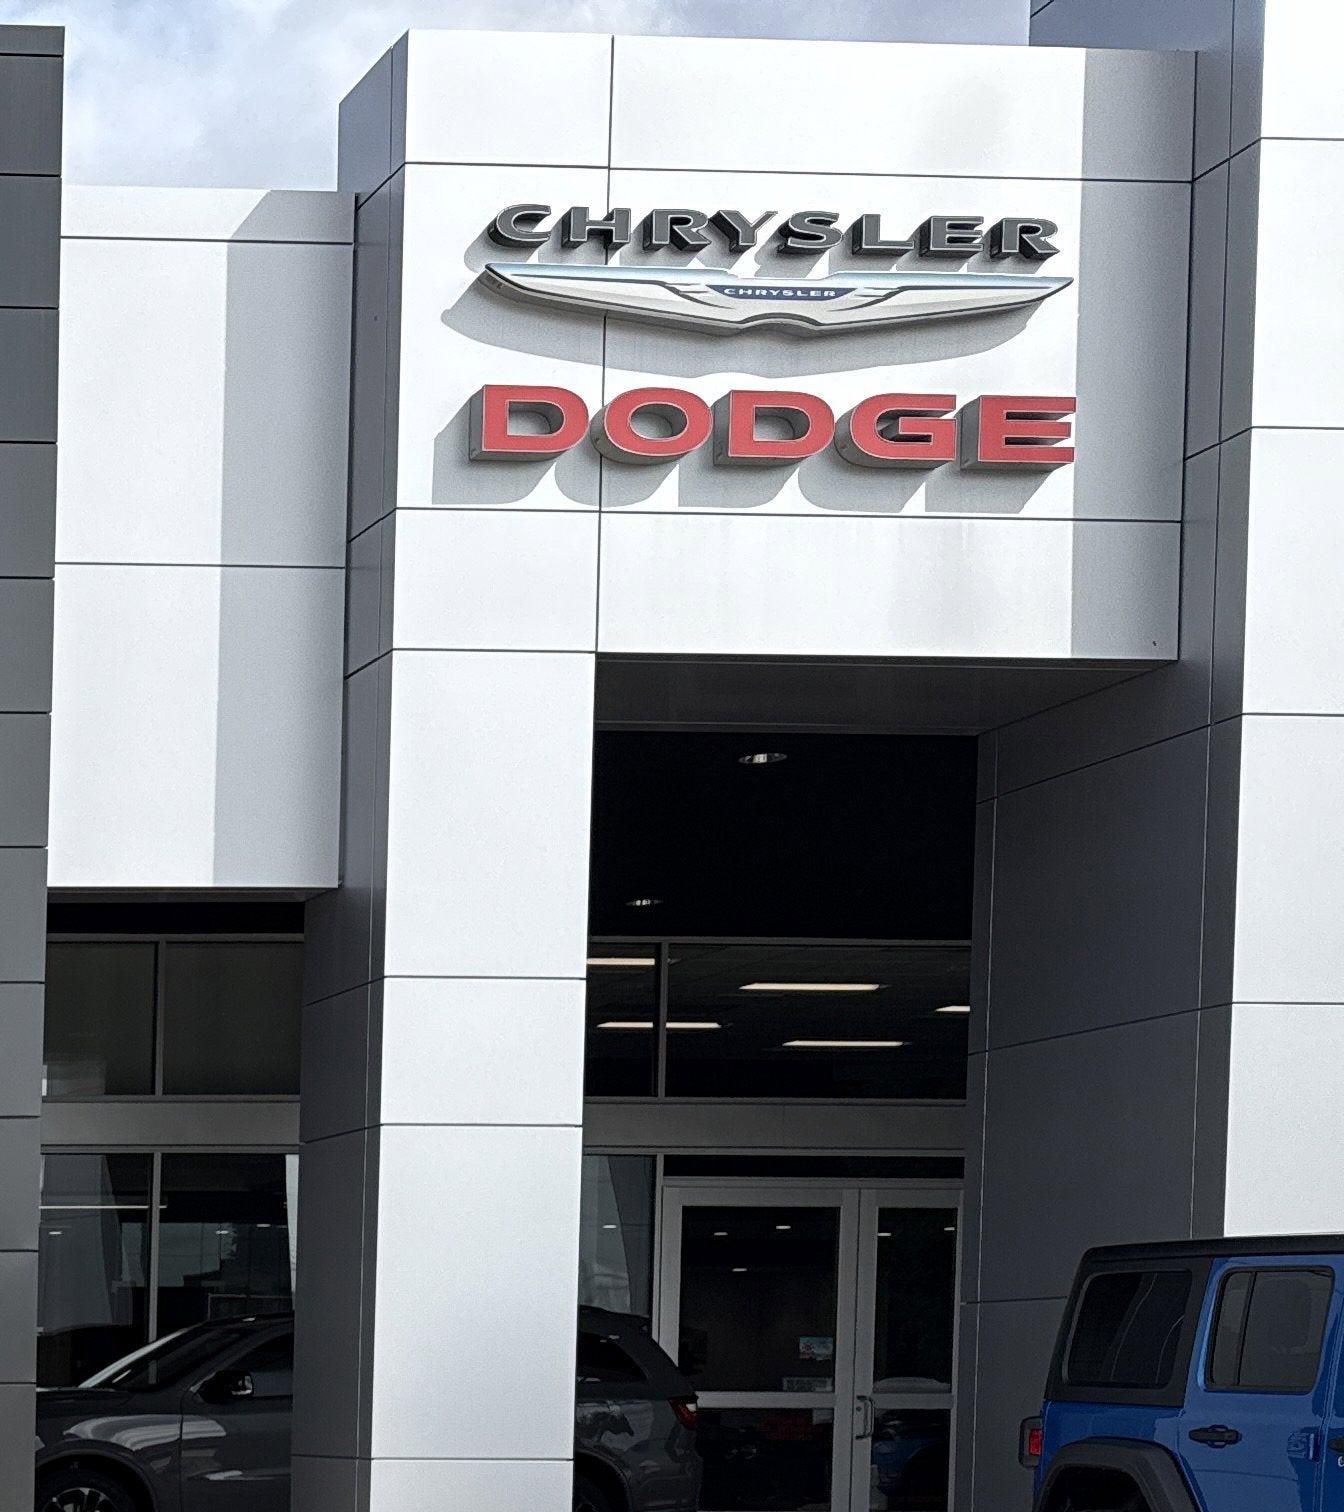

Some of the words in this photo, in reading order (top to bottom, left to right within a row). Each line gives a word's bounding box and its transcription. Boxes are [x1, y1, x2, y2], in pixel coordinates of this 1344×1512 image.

[488, 204, 1059, 260] CHRYSLER
[723, 288, 836, 297] CHRYSLER
[469, 384, 1076, 470] DODGE
